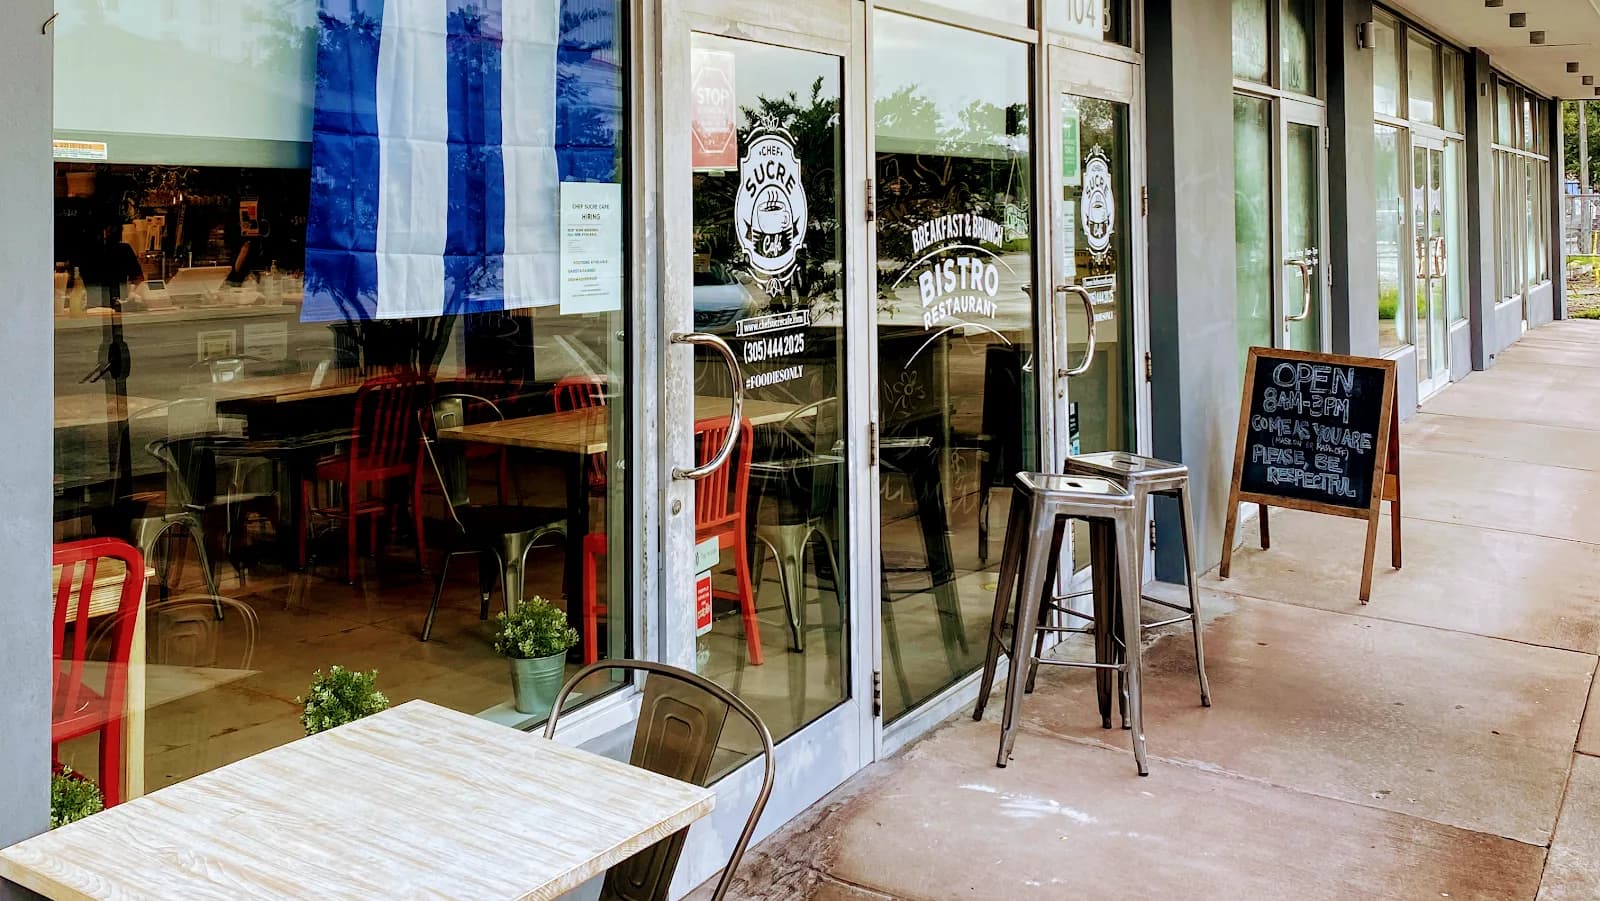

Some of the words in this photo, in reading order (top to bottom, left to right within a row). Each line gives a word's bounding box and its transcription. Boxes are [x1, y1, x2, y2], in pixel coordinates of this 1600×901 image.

[696, 87, 730, 105] STOP
[762, 146, 780, 156] CHEF
[745, 160, 796, 198] SUCRE
[911, 213, 965, 254] BREAKFAST
[964, 213, 972, 237] &
[972, 214, 1004, 248] BRUNCH
[918, 256, 999, 308] BISTRO
[923, 295, 998, 331] RESTAURANT
[745, 364, 804, 390] #FOODIESONLY
[1273, 363, 1354, 397] OPEN
[1252, 415, 1292, 437] COME
[1293, 420, 1310, 440] AS
[1312, 423, 1342, 446] YOU
[1341, 429, 1372, 454] ARE
[1315, 453, 1344, 473] BE
[1266, 466, 1357, 498] RESPECTFUL
